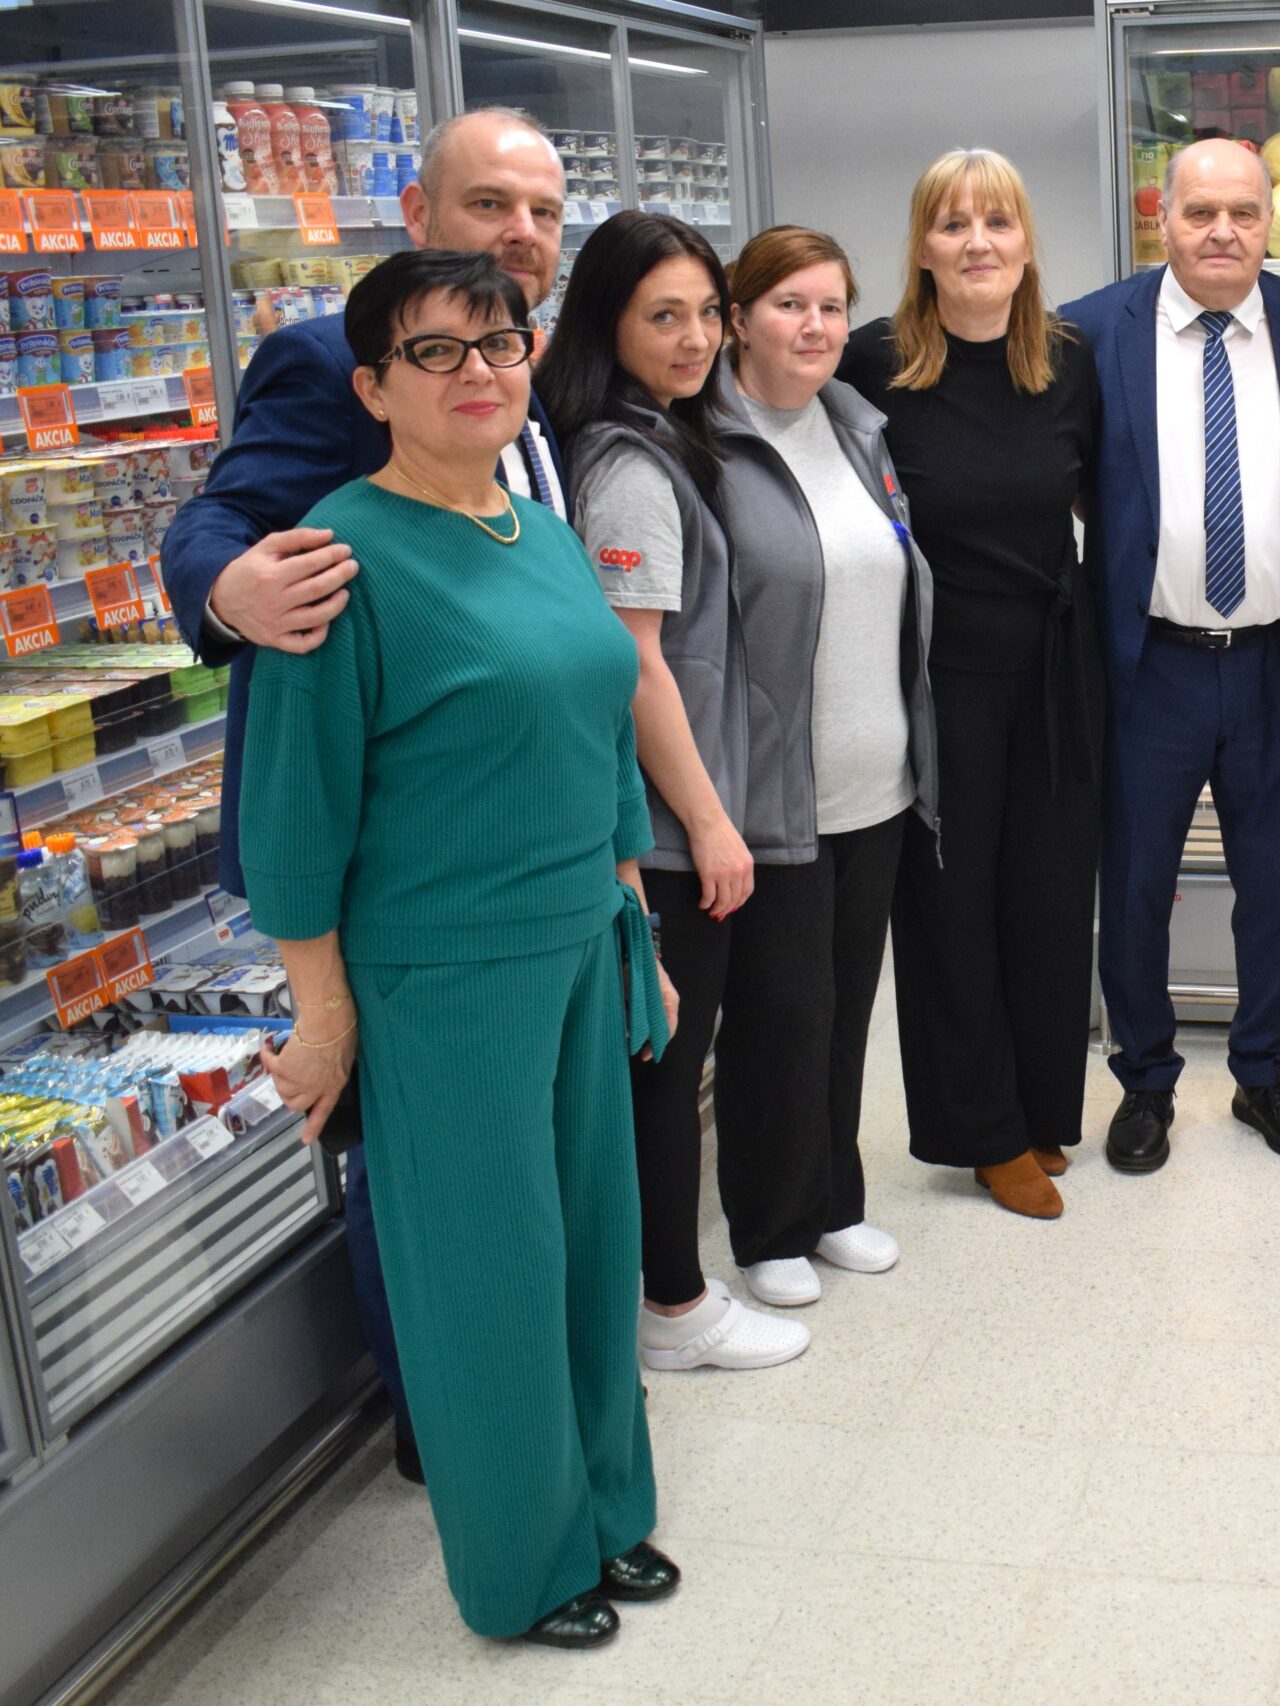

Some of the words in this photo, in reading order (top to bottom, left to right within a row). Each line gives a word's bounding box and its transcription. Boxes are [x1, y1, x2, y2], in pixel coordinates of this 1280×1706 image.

[1135, 220, 1161, 231] JABLK
[0, 233, 21, 250] CIA
[41, 232, 80, 250] AKCIA
[100, 230, 136, 248] AKCIA
[147, 230, 182, 248] AKCIA
[307, 229, 336, 243] AKCIA
[198, 406, 216, 424] AKC
[35, 427, 74, 449] AKCIA
[600, 547, 641, 573] coop
[103, 604, 140, 627] AKCIA
[14, 629, 55, 655] AKCIA
[113, 969, 150, 998] AKCIA
[66, 993, 104, 1025] AKCIA
